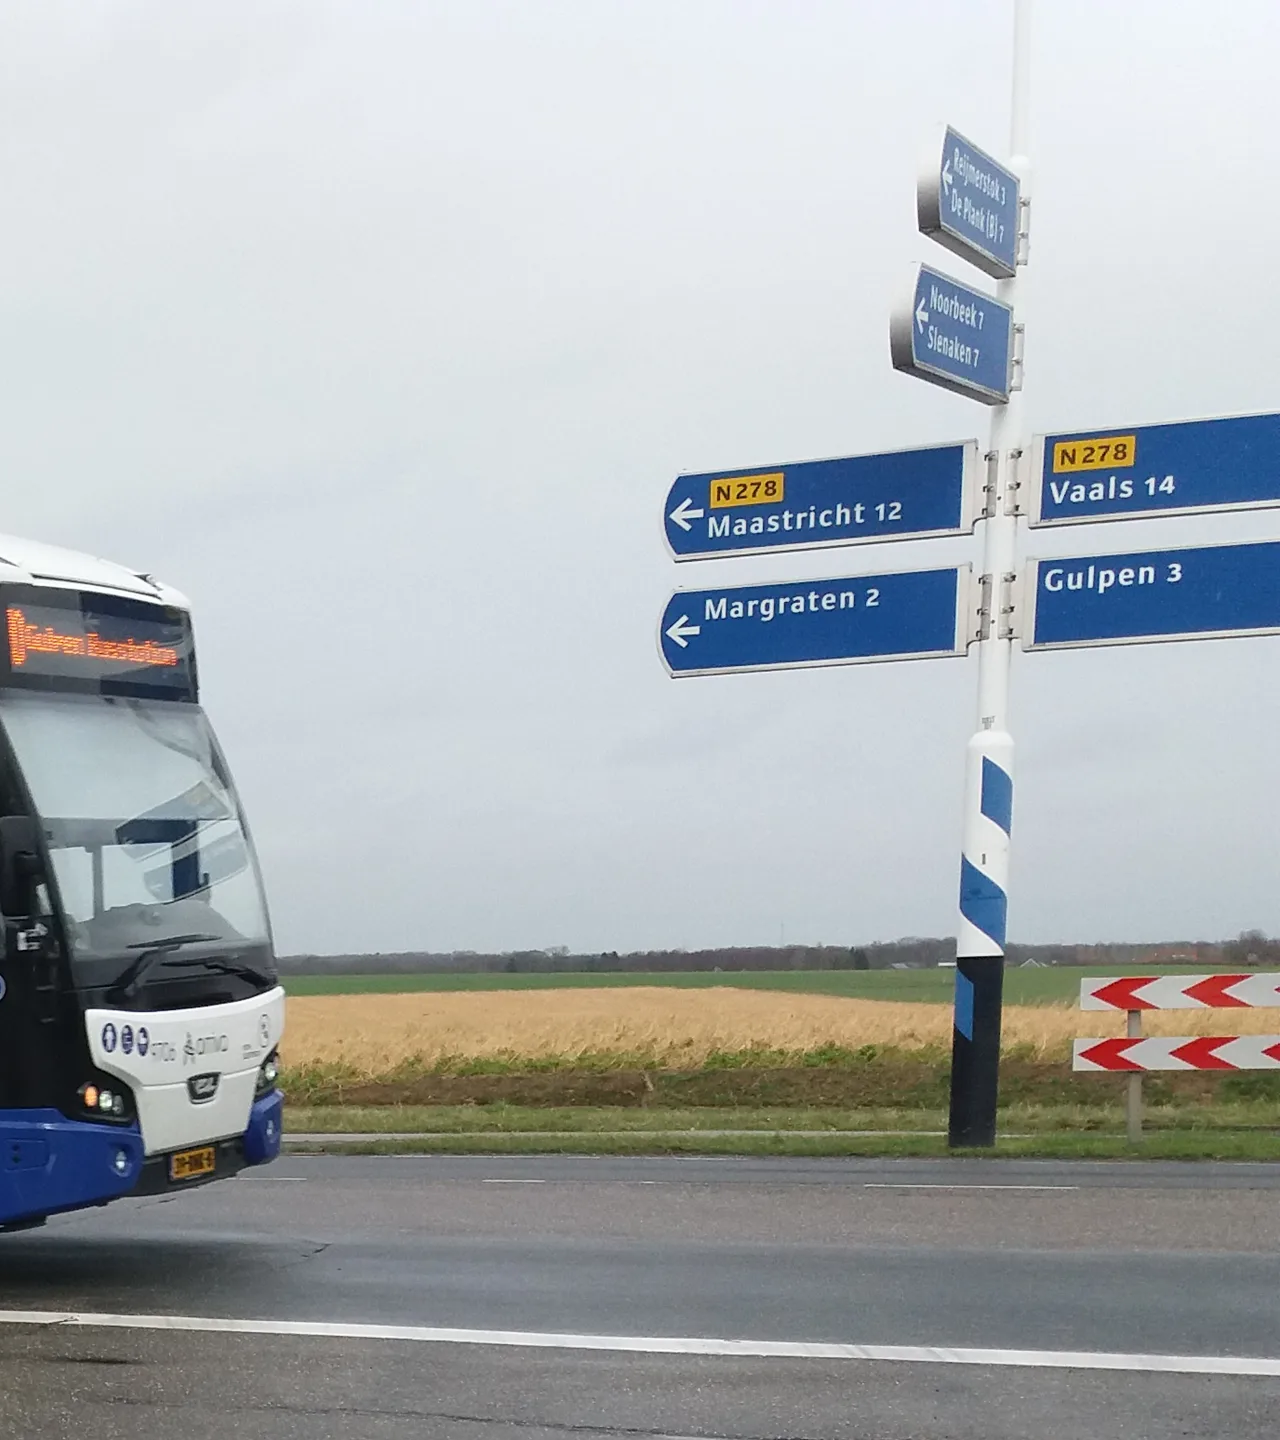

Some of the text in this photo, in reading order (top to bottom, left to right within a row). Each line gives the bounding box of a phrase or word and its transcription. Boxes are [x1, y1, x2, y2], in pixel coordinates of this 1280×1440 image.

[1001, 186, 1006, 206] 3
[951, 188, 962, 216] De
[963, 196, 985, 232] Plank
[999, 225, 1004, 243] 7
[930, 284, 984, 330] Noorbeek 7
[927, 325, 979, 368] Slenaken 7
[1049, 475, 1176, 504] Vaals 14
[707, 502, 902, 539] Maastricht 12
[1044, 563, 1182, 593] Gulpen 3
[704, 588, 880, 622] Margraten 2
